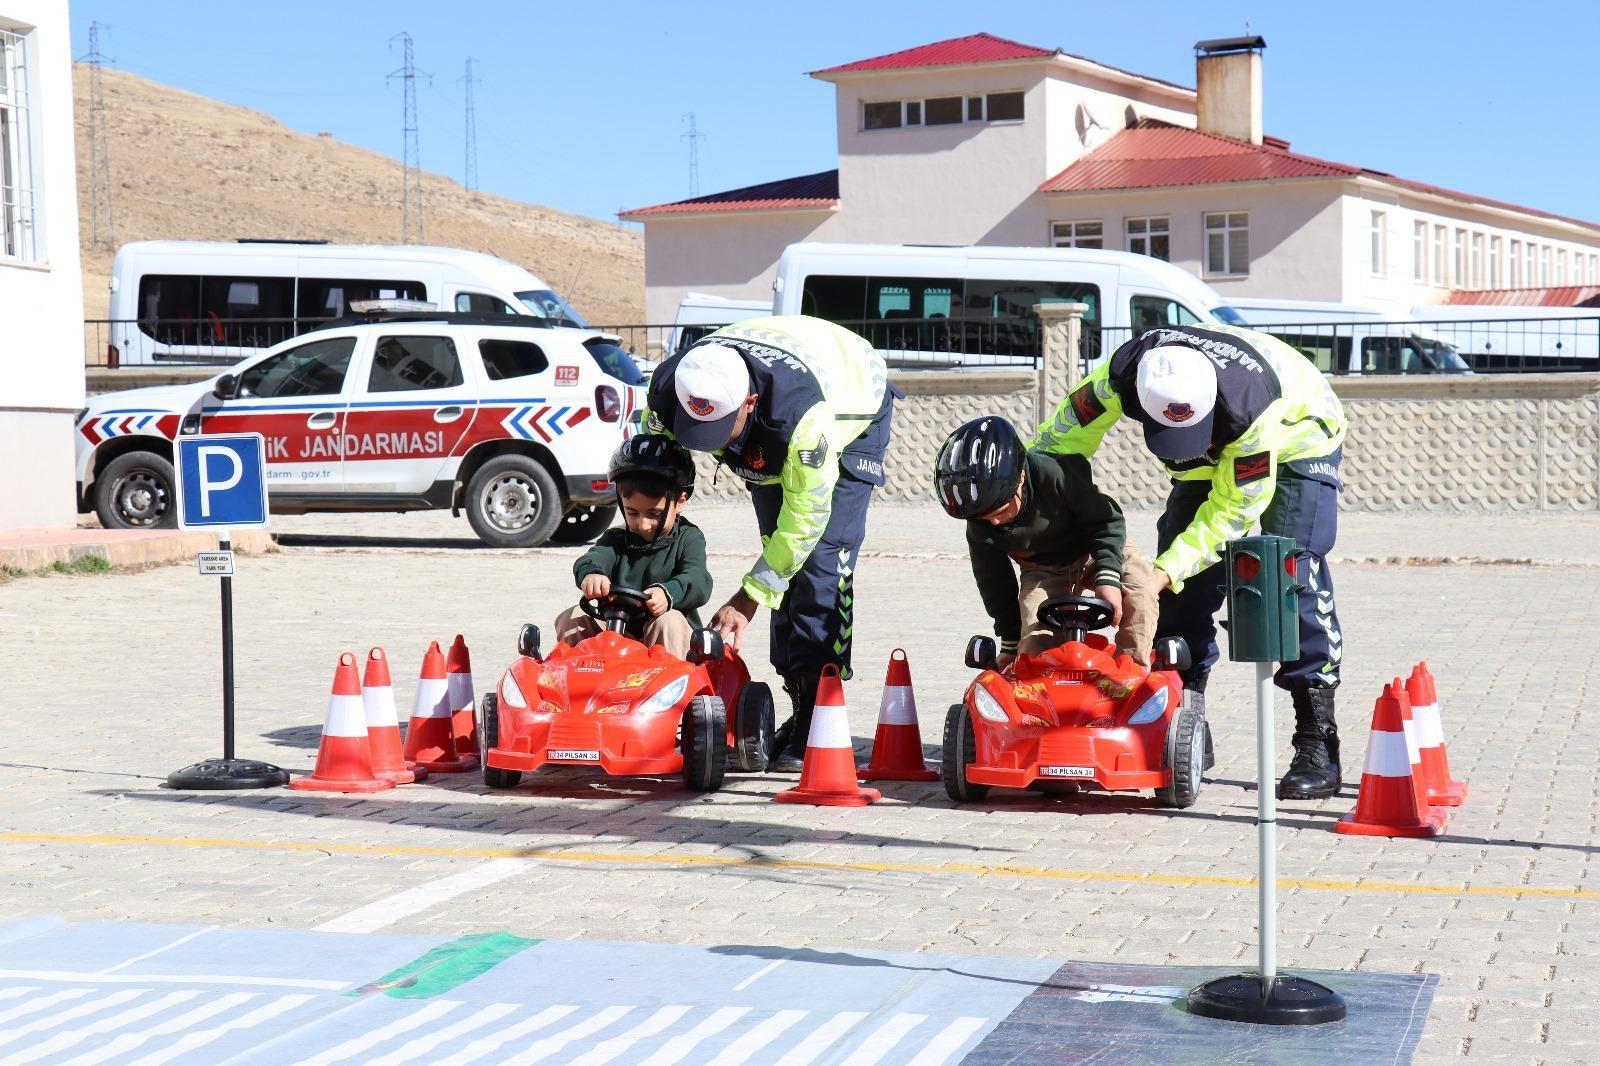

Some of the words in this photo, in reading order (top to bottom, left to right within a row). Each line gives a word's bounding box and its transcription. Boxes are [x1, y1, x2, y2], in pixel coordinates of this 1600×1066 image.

[558, 367, 576, 379] 112
[300, 431, 444, 458] JANDARMASI
[198, 445, 243, 517] P
